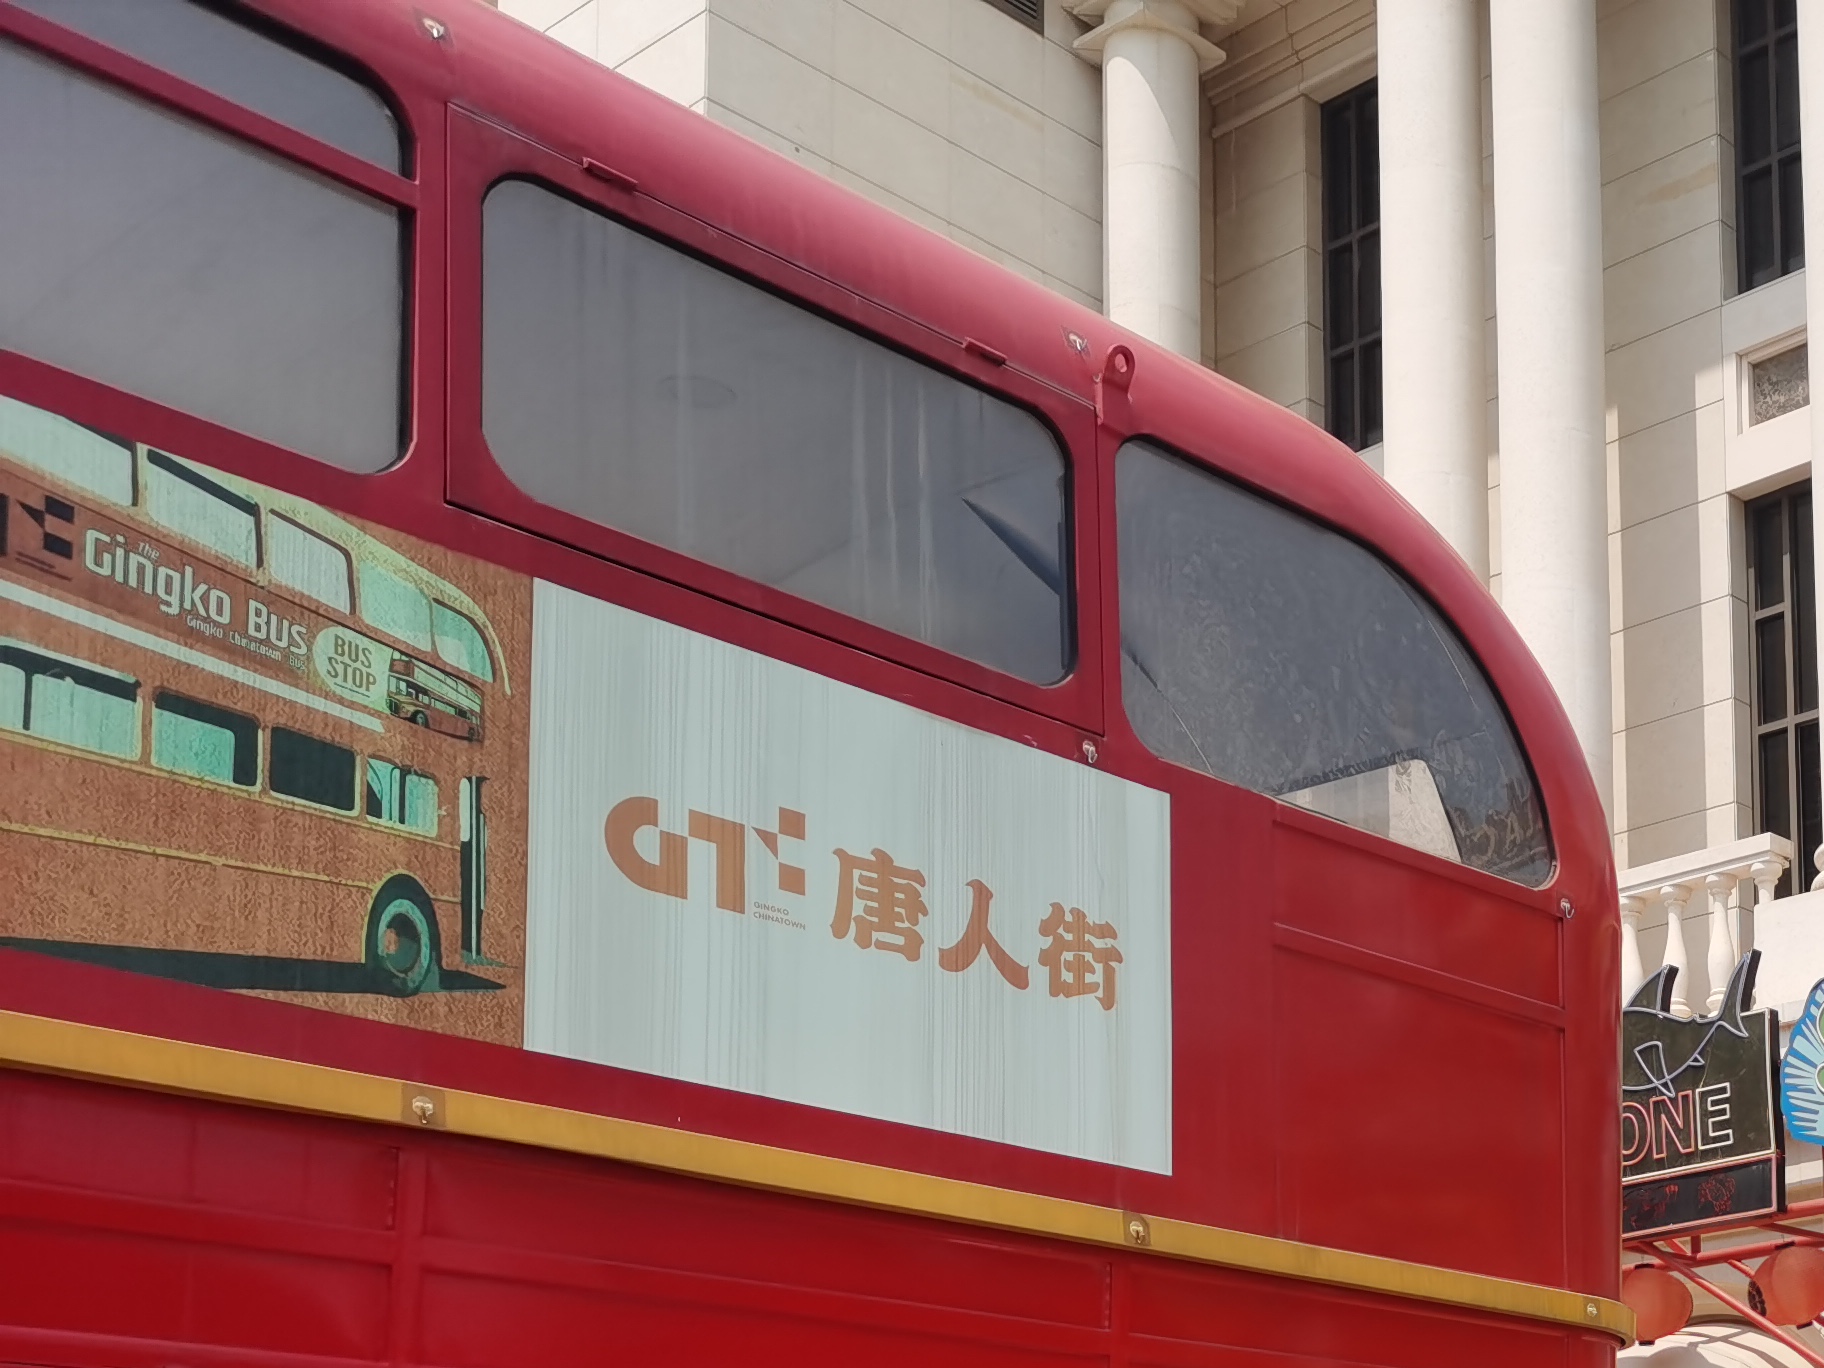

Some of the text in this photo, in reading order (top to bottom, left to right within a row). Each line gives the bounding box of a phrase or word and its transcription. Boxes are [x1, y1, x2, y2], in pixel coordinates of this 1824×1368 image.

[332, 633, 373, 669] BUS
[326, 656, 378, 693] STOP
[753, 900, 790, 917] GINGKO
[753, 911, 806, 931] CHINATOWN
[830, 847, 1123, 1012] 唐人街
